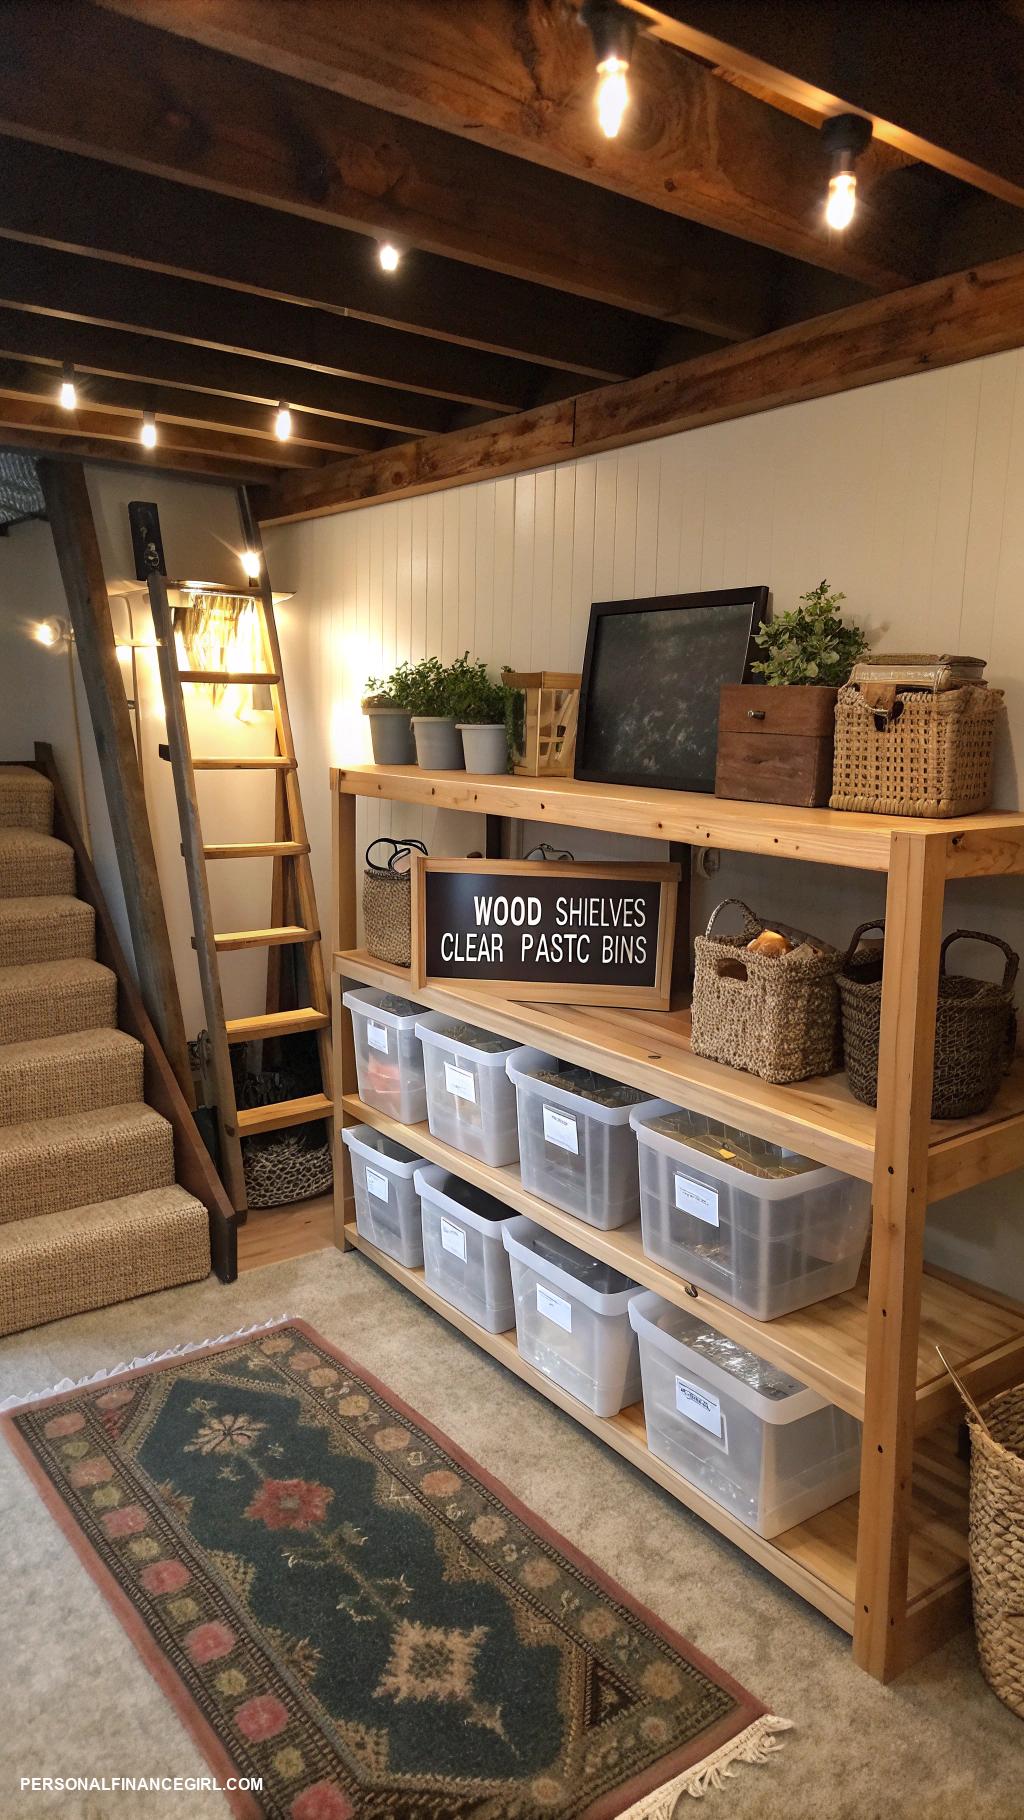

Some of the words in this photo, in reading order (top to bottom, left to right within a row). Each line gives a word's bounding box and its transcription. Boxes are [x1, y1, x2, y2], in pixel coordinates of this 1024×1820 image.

[473, 895, 542, 927] WOOD
[555, 896, 646, 928] SHIELVES
[440, 932, 504, 962] CLEAR
[521, 933, 590, 964] PASTC
[602, 935, 647, 964] BINS
